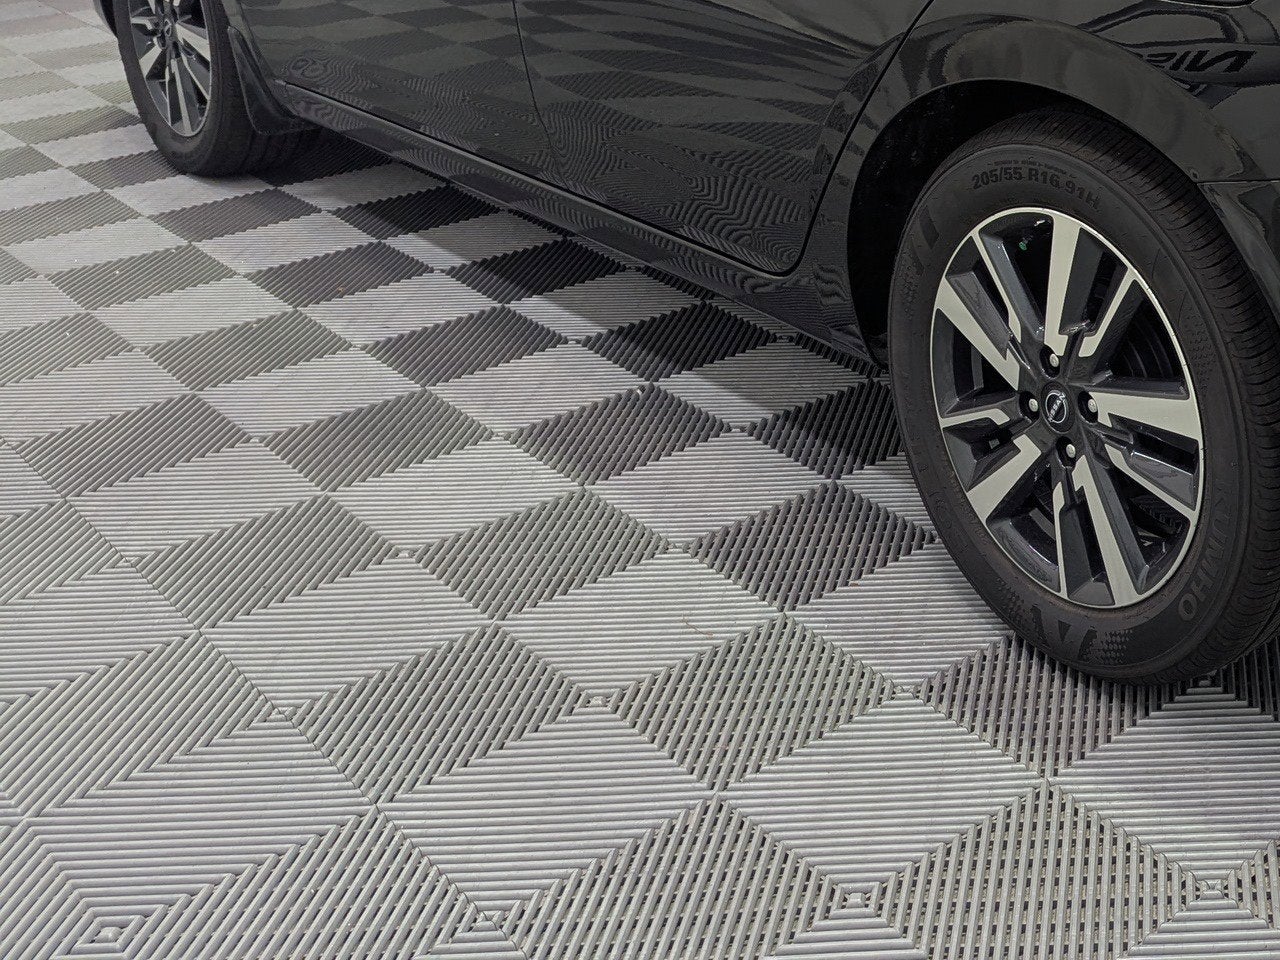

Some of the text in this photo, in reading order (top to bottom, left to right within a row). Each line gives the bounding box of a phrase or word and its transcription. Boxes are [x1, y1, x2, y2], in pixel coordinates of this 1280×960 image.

[972, 166, 1023, 190] 205/55
[1028, 168, 1060, 189] R16
[1065, 180, 1101, 211] 91H
